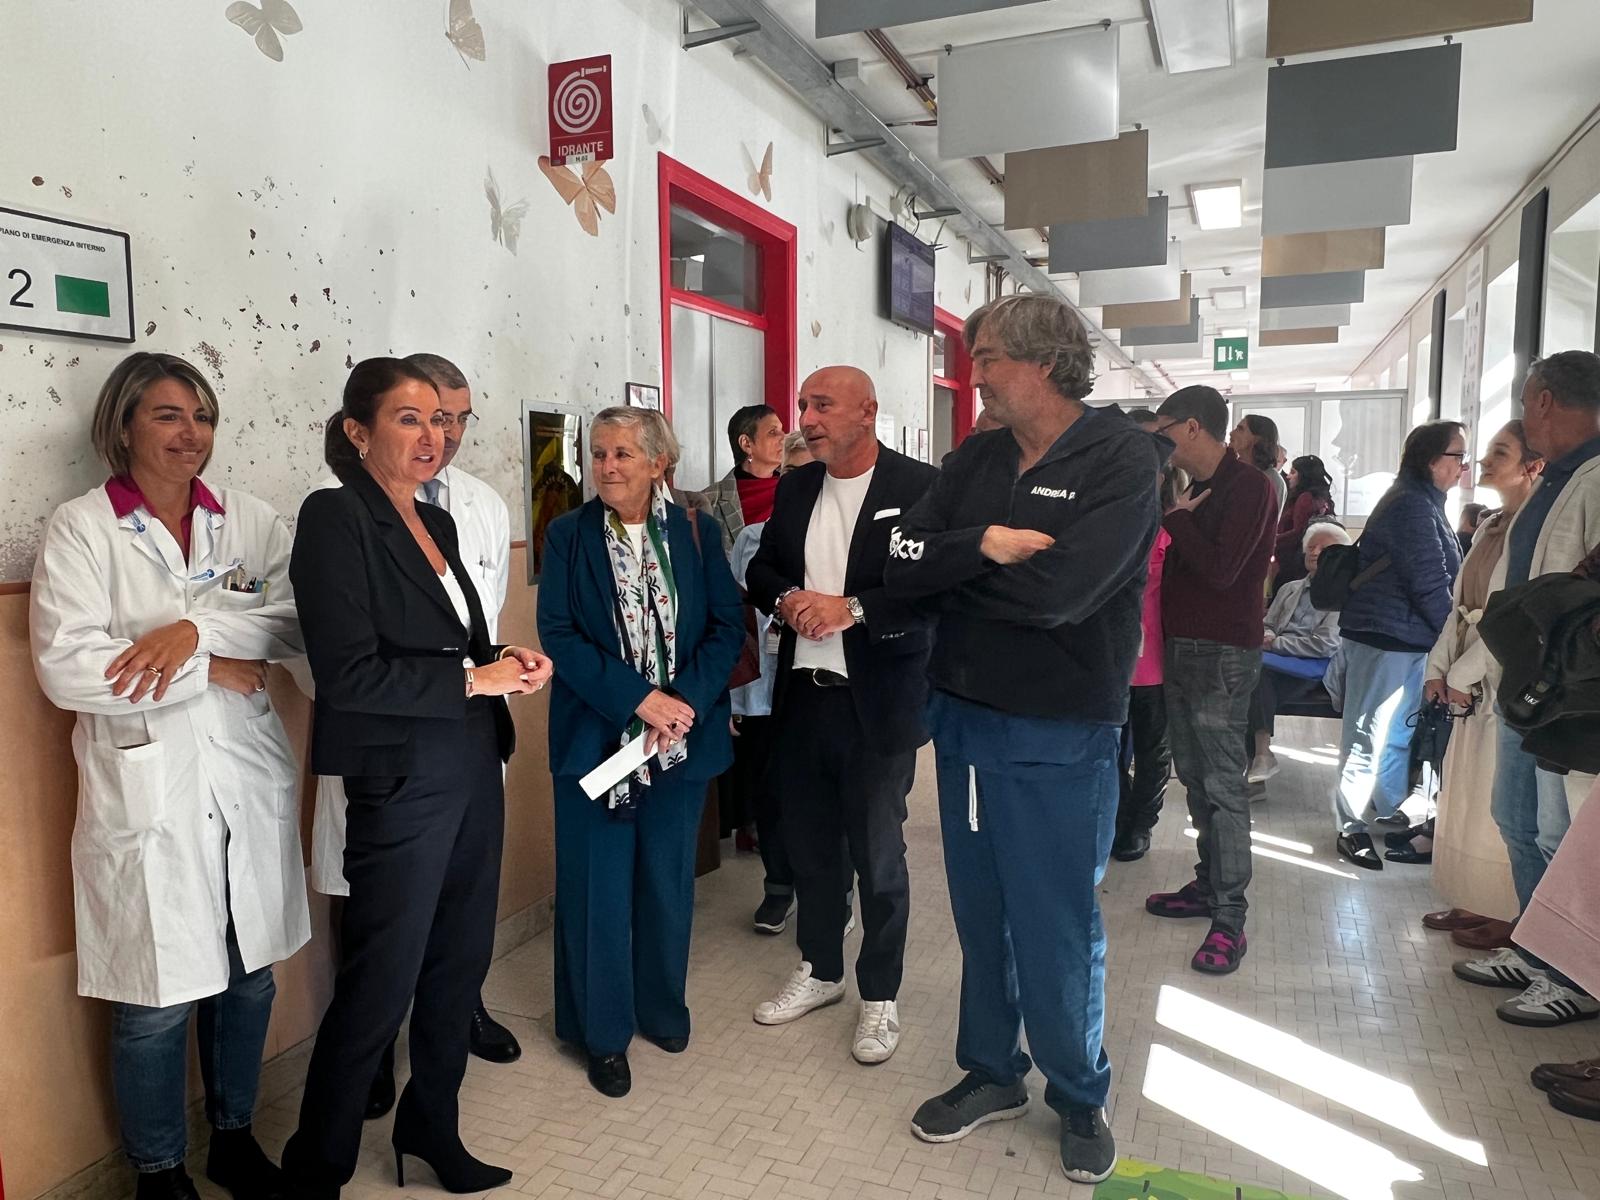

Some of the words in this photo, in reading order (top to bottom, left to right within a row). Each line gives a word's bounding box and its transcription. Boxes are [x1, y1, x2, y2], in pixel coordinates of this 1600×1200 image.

[558, 141, 604, 157] IDRANTE
[22, 231, 30, 239] DI
[31, 233, 75, 247] EMERGENZA
[76, 241, 106, 253] INTERNO
[8, 268, 34, 308] 2
[1030, 485, 1067, 499] ANDREA
